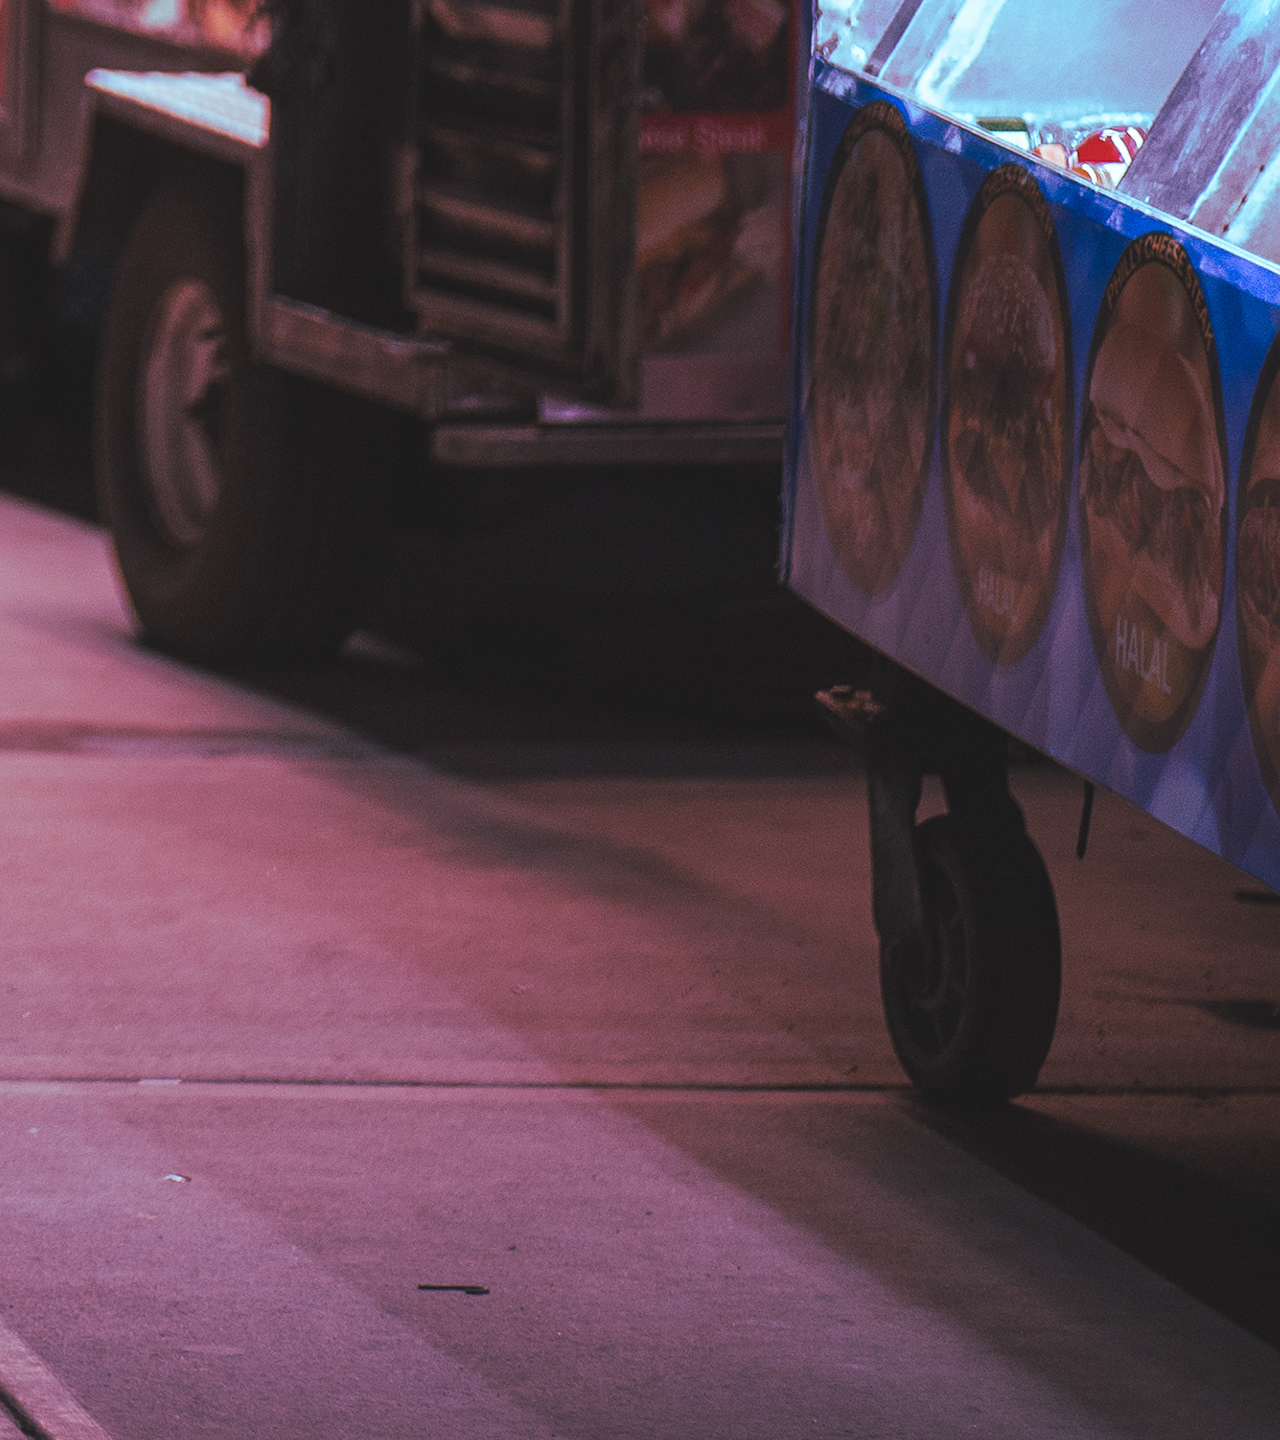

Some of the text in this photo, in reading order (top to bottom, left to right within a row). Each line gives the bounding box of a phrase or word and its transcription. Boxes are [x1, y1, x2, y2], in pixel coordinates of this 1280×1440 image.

[1107, 240, 1142, 309] PHILLY
[1144, 234, 1187, 274] CHEESE
[1116, 616, 1172, 693] HALAL
